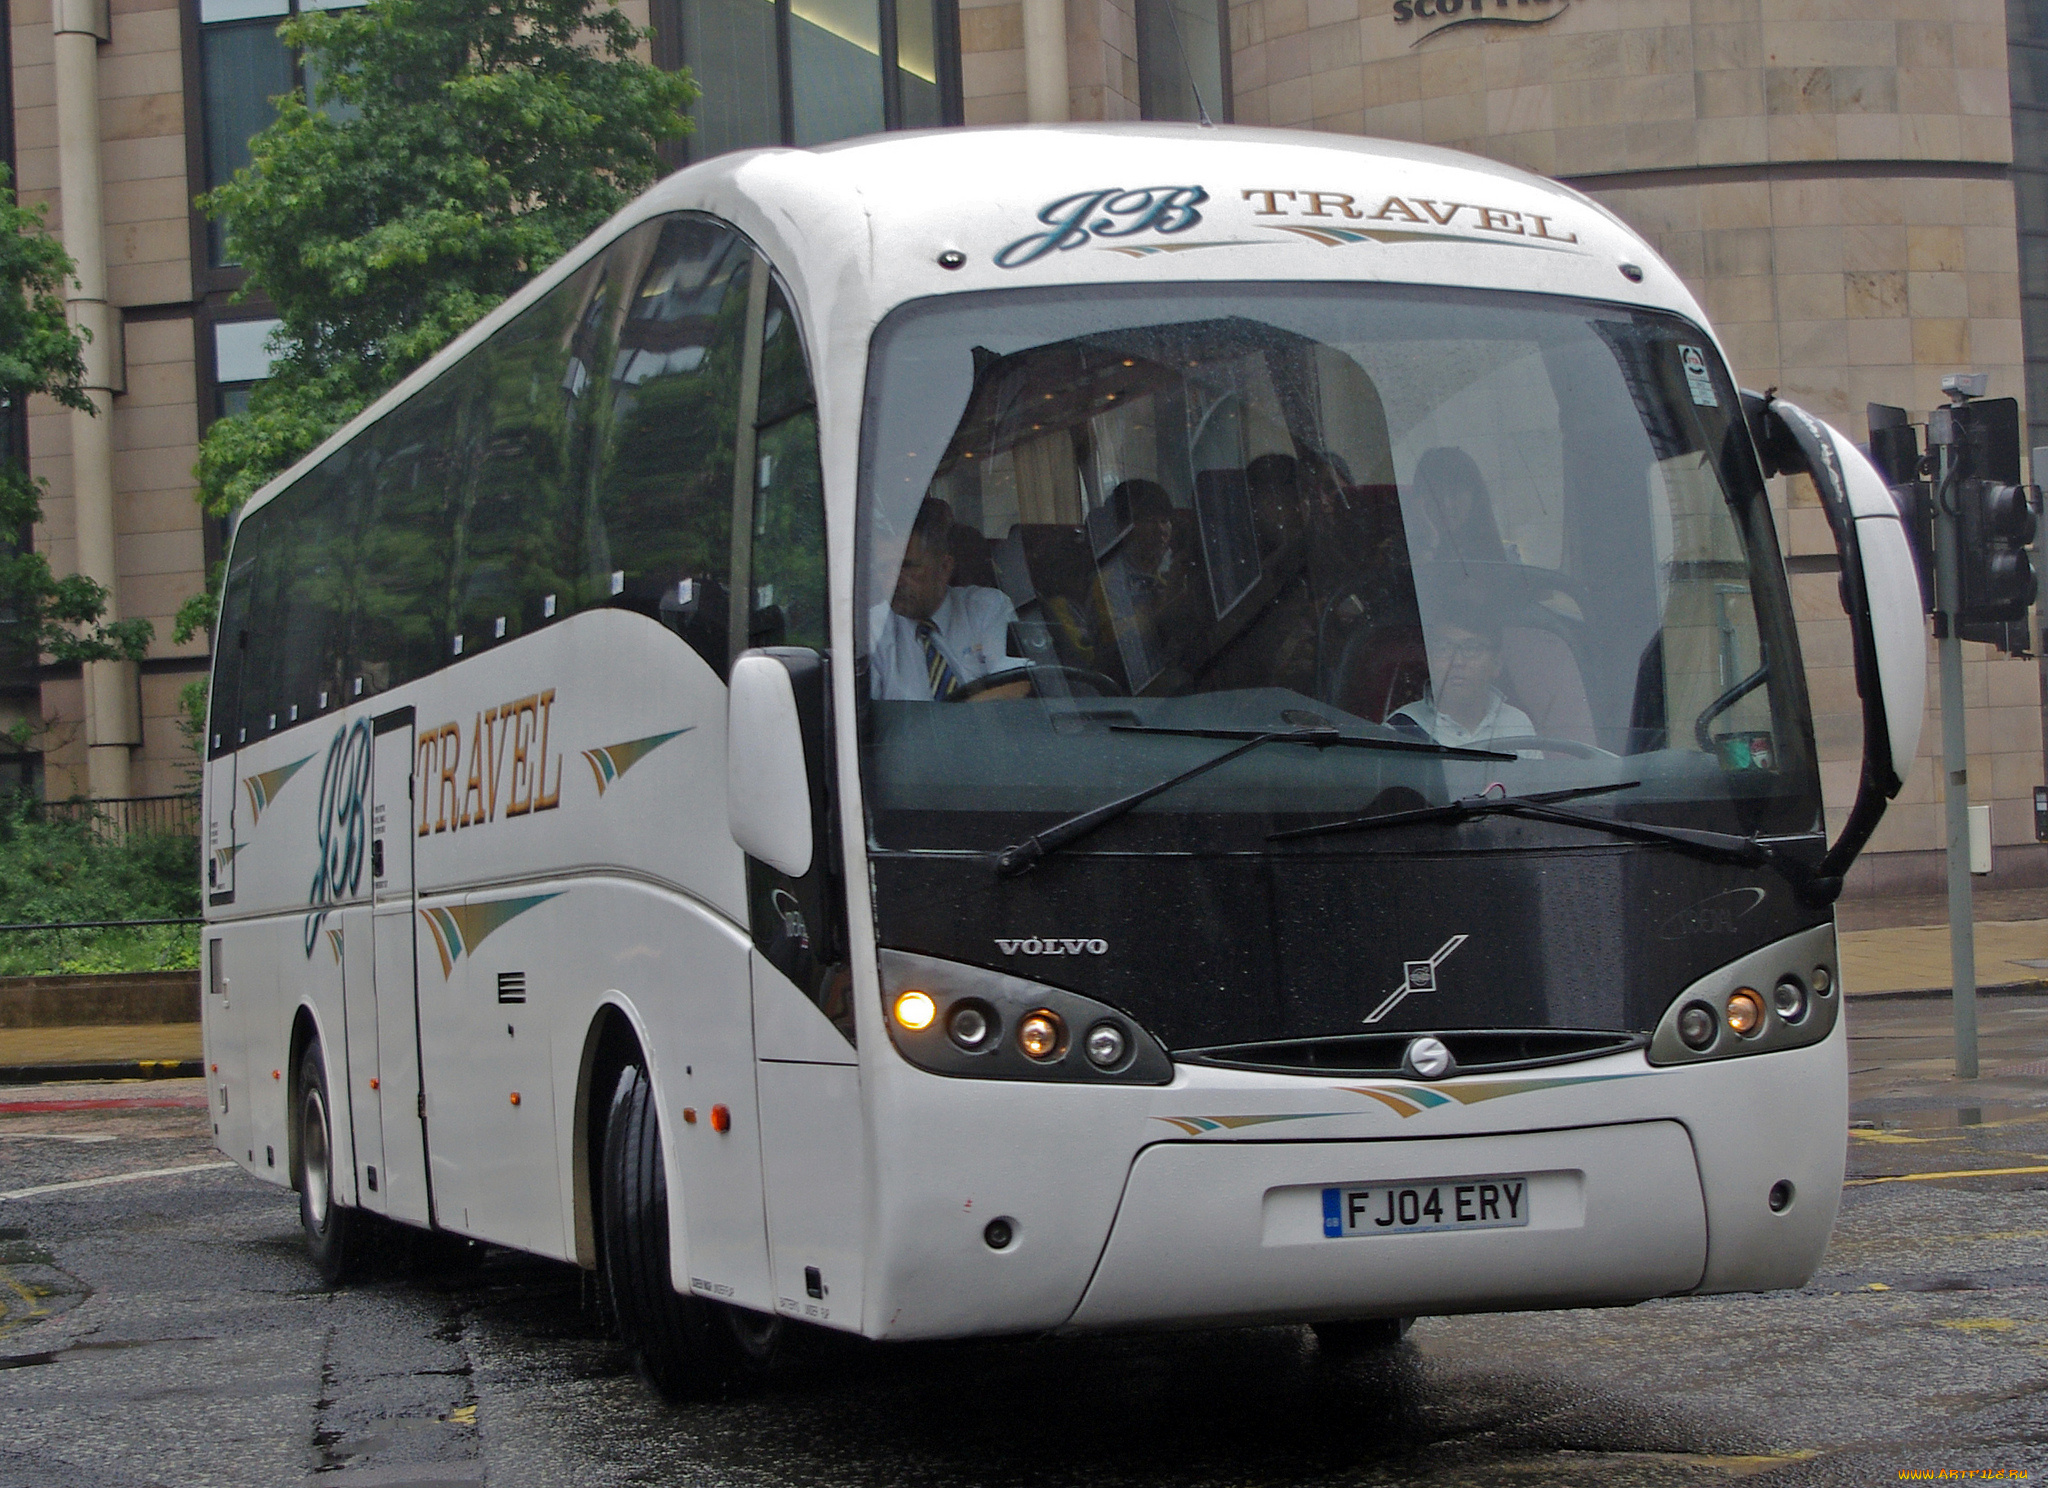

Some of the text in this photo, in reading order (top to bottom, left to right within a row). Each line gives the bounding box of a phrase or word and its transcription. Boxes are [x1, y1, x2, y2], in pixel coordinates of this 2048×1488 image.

[993, 185, 1578, 268] JB TRAVEL
[305, 688, 563, 958] JB TRAVEL
[994, 938, 1109, 956] VOLVO
[1348, 1182, 1522, 1228] FJ04 ERY
